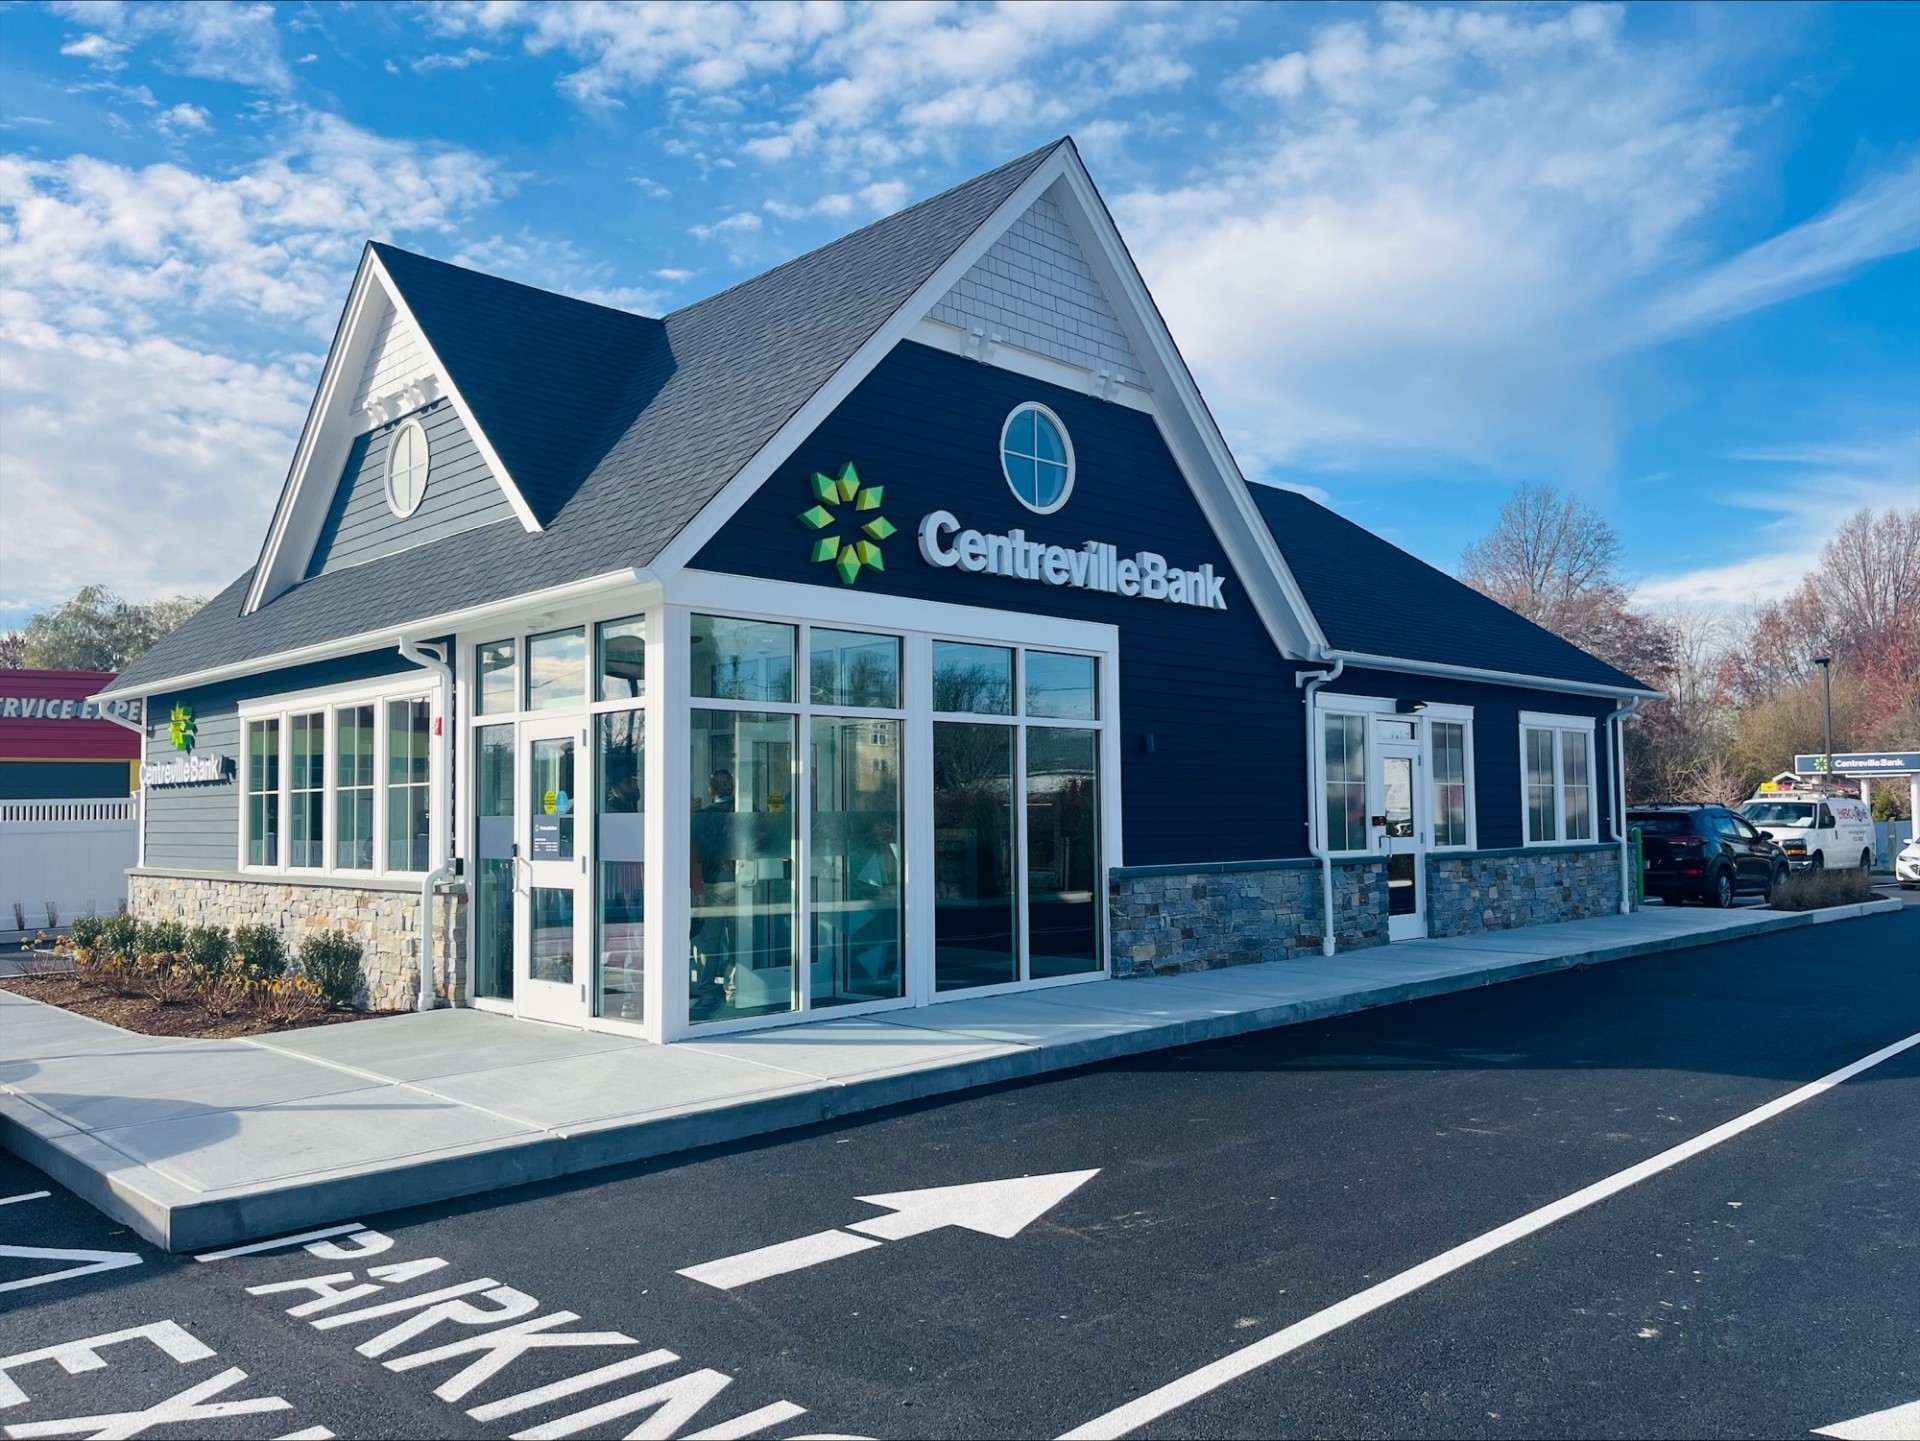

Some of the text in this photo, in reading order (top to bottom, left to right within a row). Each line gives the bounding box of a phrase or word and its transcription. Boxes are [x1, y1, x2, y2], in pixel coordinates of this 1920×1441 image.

[918, 510, 1227, 610] CentrevilleBank
[139, 753, 219, 786] CentrevilleBank
[0, 1319, 335, 1440] EX
[194, 1223, 881, 1440] PARKIN
